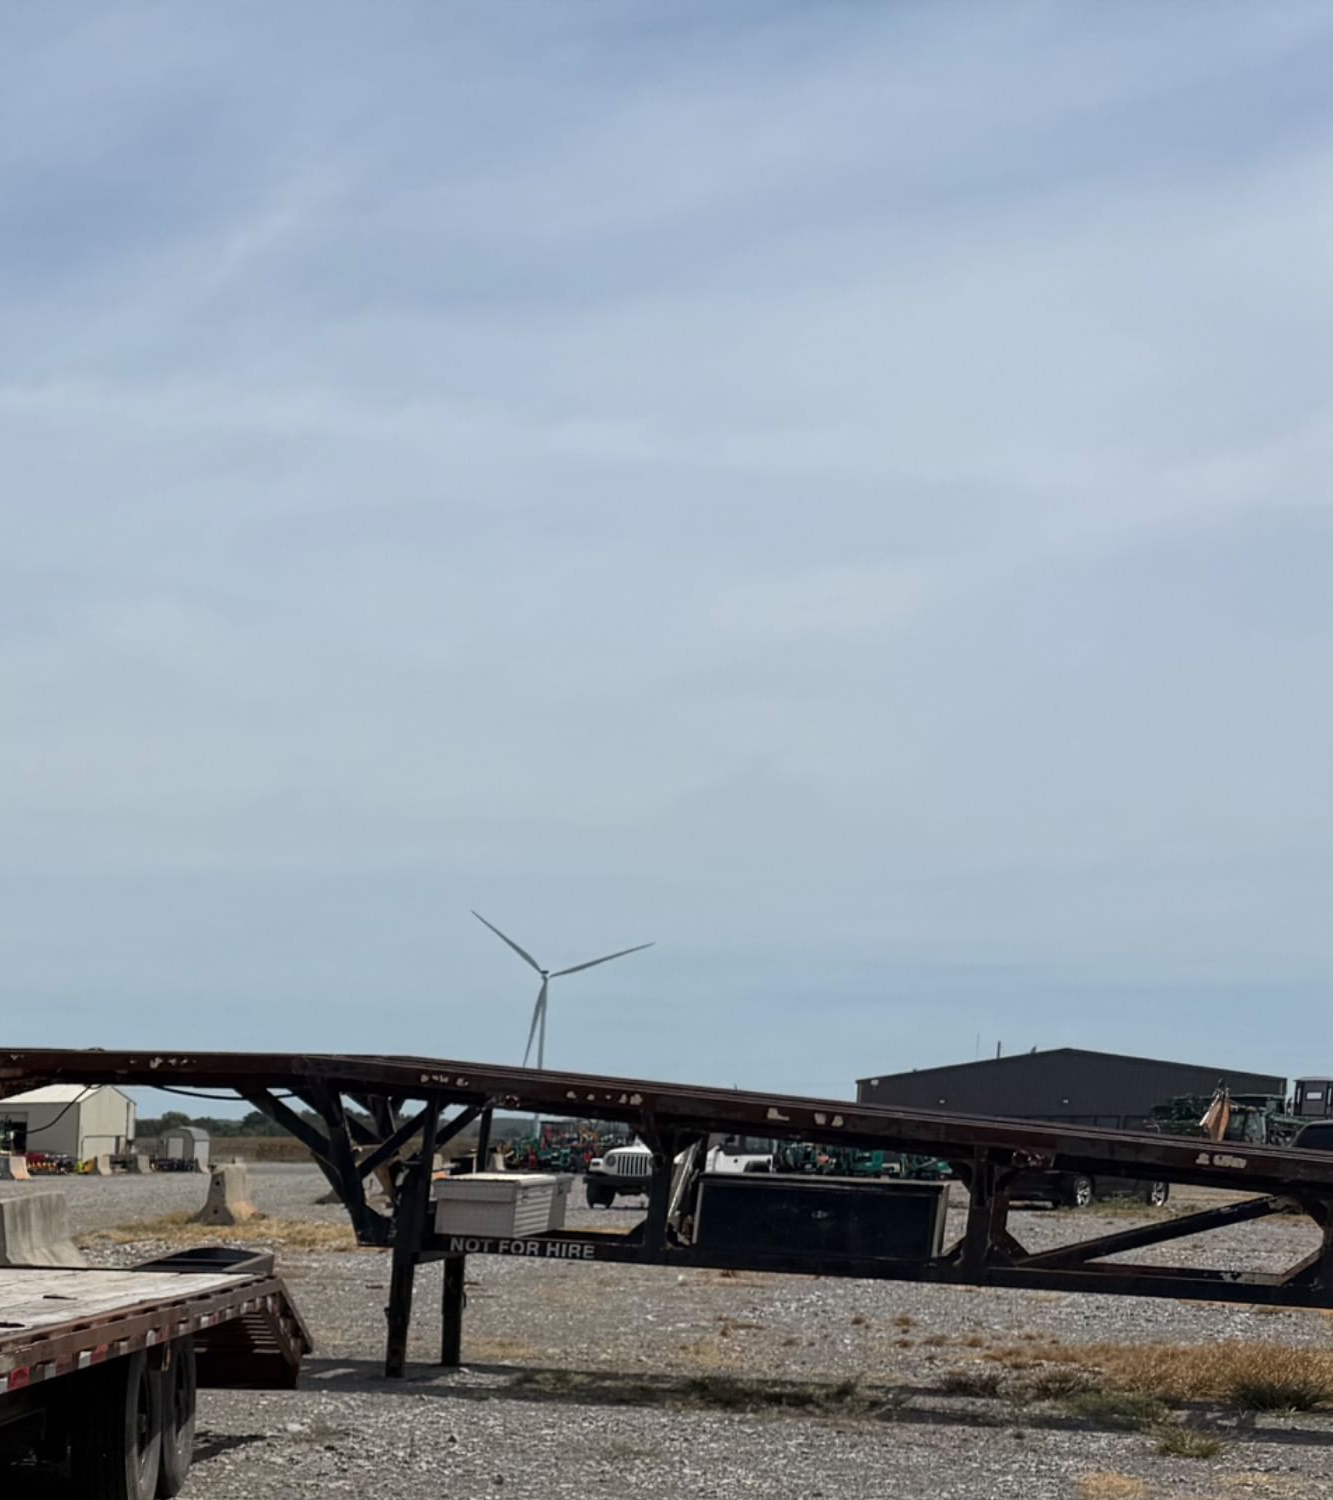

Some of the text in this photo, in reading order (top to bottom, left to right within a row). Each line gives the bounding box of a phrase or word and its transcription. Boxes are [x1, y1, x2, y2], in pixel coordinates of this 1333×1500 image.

[450, 1237, 595, 1259] NOT FOR HIRE
